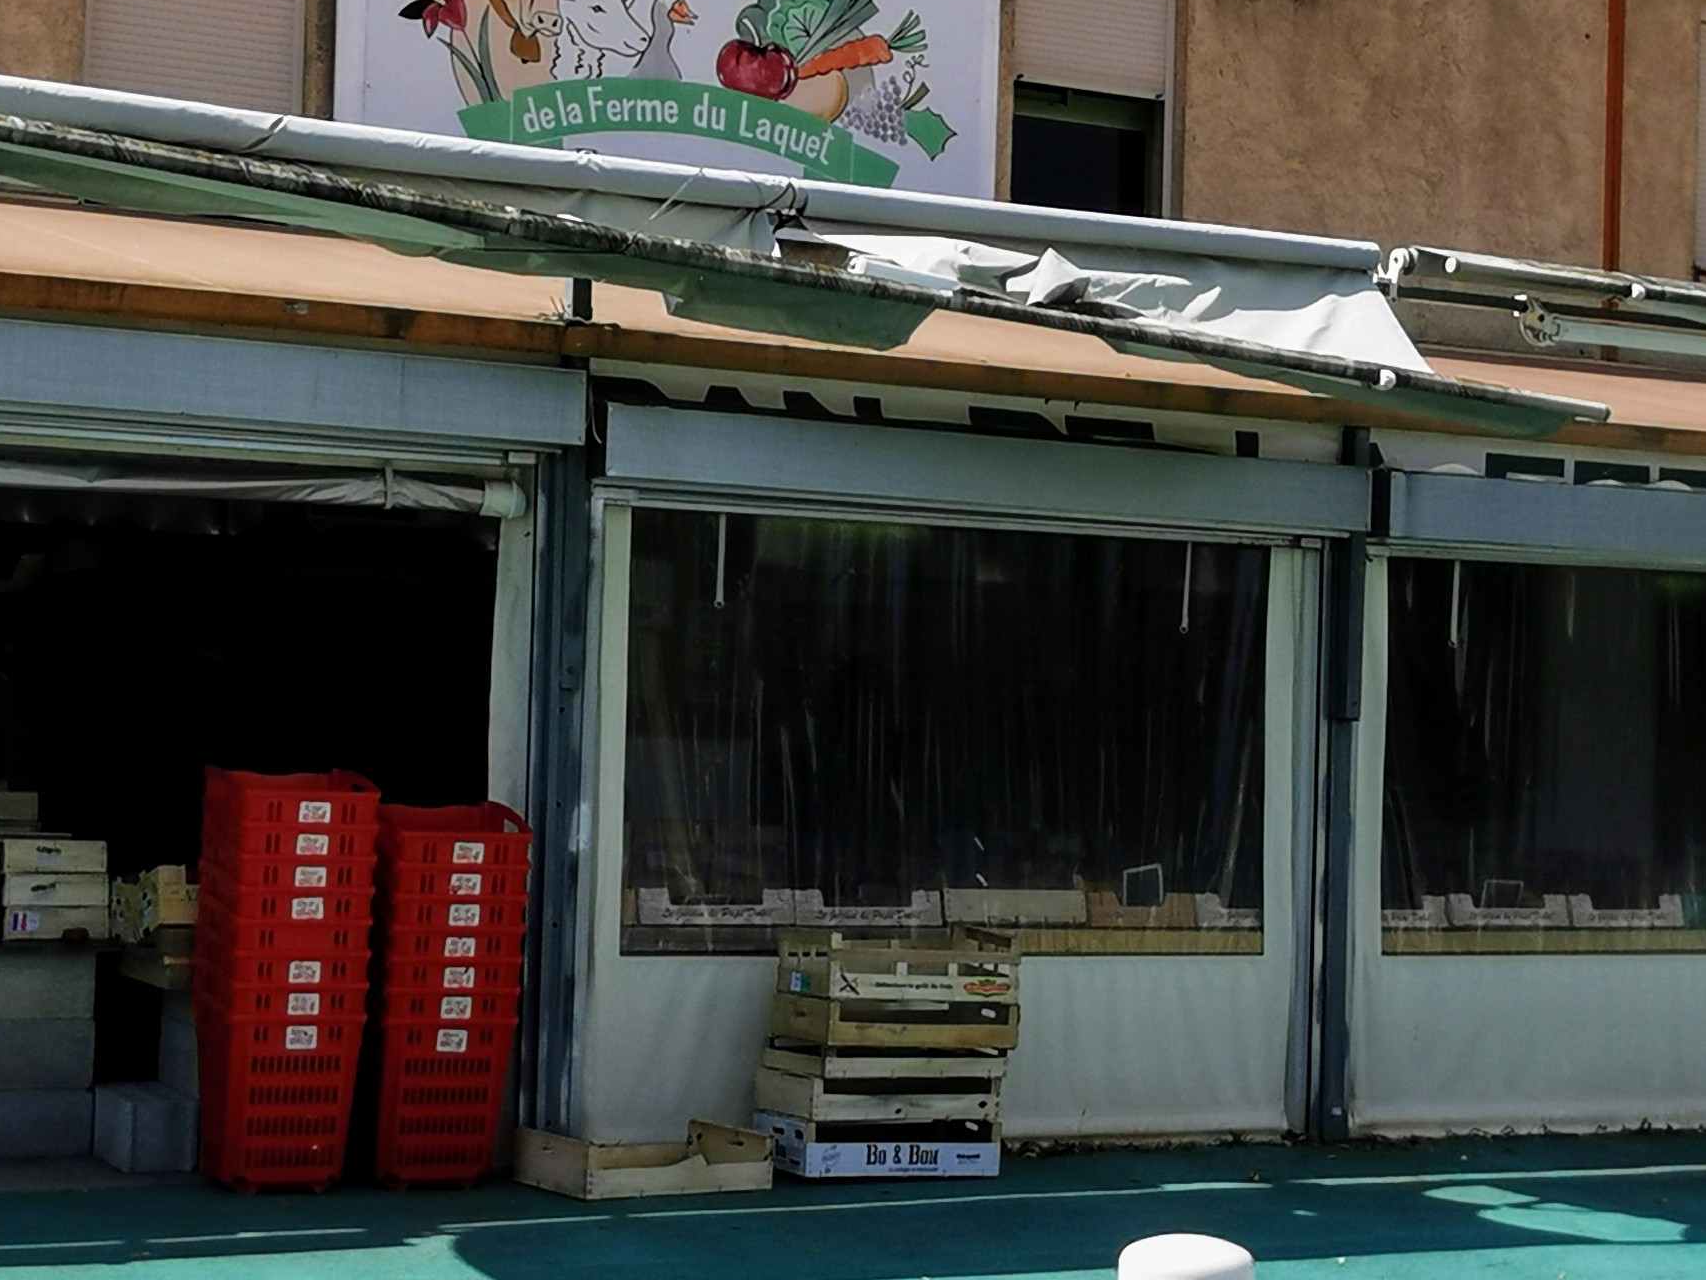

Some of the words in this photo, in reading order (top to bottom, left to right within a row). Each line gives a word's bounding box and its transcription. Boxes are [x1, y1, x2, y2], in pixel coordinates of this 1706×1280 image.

[586, 86, 680, 125] Ferme
[693, 92, 726, 131] du
[738, 100, 835, 165] Laquet
